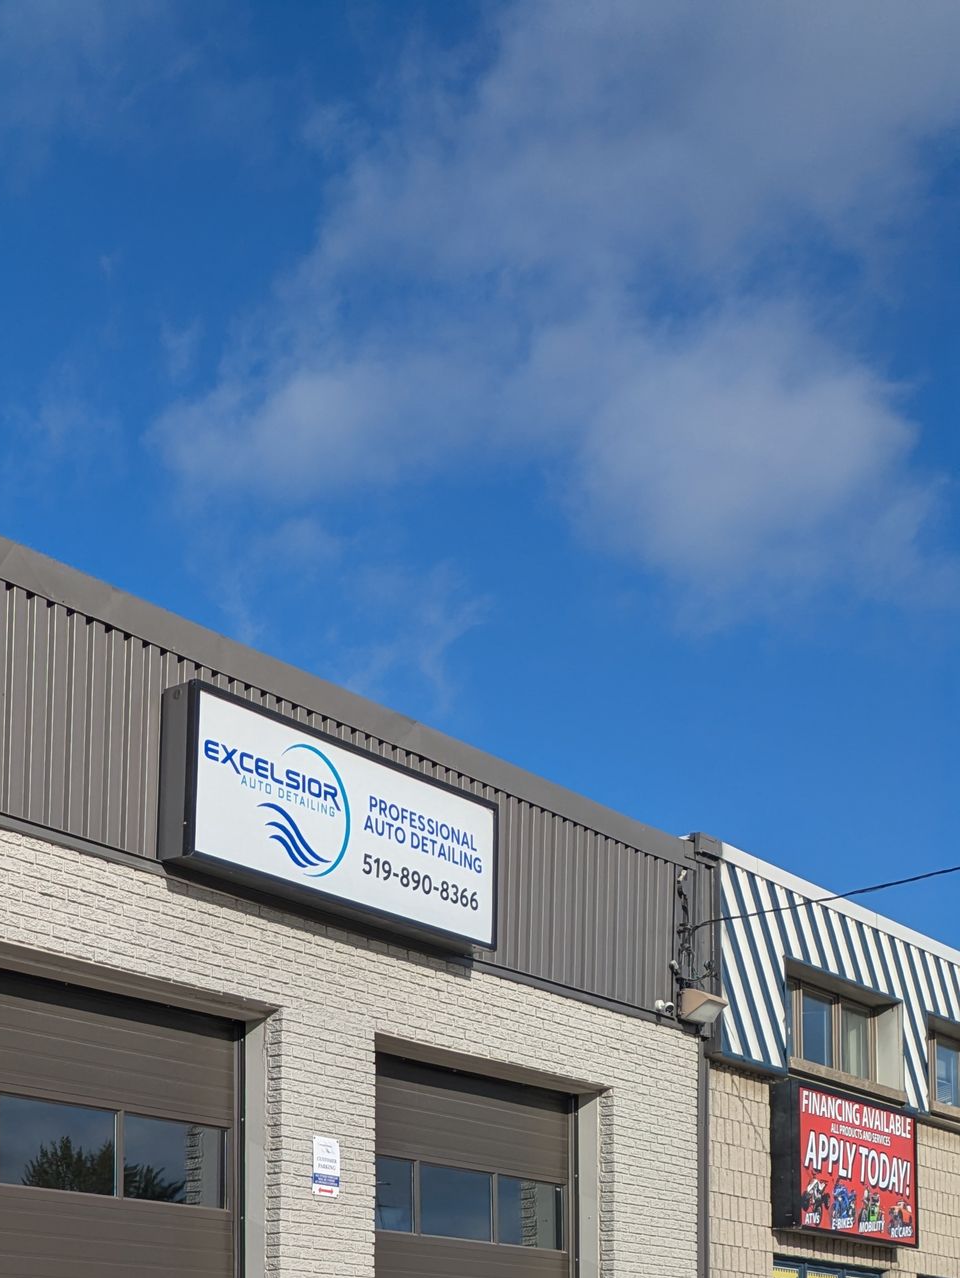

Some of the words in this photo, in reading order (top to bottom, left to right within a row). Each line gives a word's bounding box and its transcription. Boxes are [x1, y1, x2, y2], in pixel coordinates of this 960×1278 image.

[204, 739, 341, 811] EXCELSIOR
[241, 775, 272, 795] AUTO
[277, 787, 336, 818] DETAILING
[363, 815, 406, 844] AUTO
[410, 832, 483, 874] DETAILING
[369, 795, 478, 852] PROFESSIONAL
[362, 854, 479, 911] 519-890-8366
[802, 1090, 860, 1126] FINANCING
[862, 1106, 911, 1139] AVAILABLE
[830, 1122, 839, 1134] ALL
[839, 1125, 863, 1141] PRODUCTS
[804, 1131, 856, 1179] APPLY
[859, 1147, 911, 1197] TODAY!
[805, 1212, 820, 1225] ATVs
[831, 1217, 854, 1230] E-BIKES
[859, 1220, 885, 1233] MOBILITY
[891, 1227, 898, 1238] RC
[898, 1226, 912, 1238] CARS
